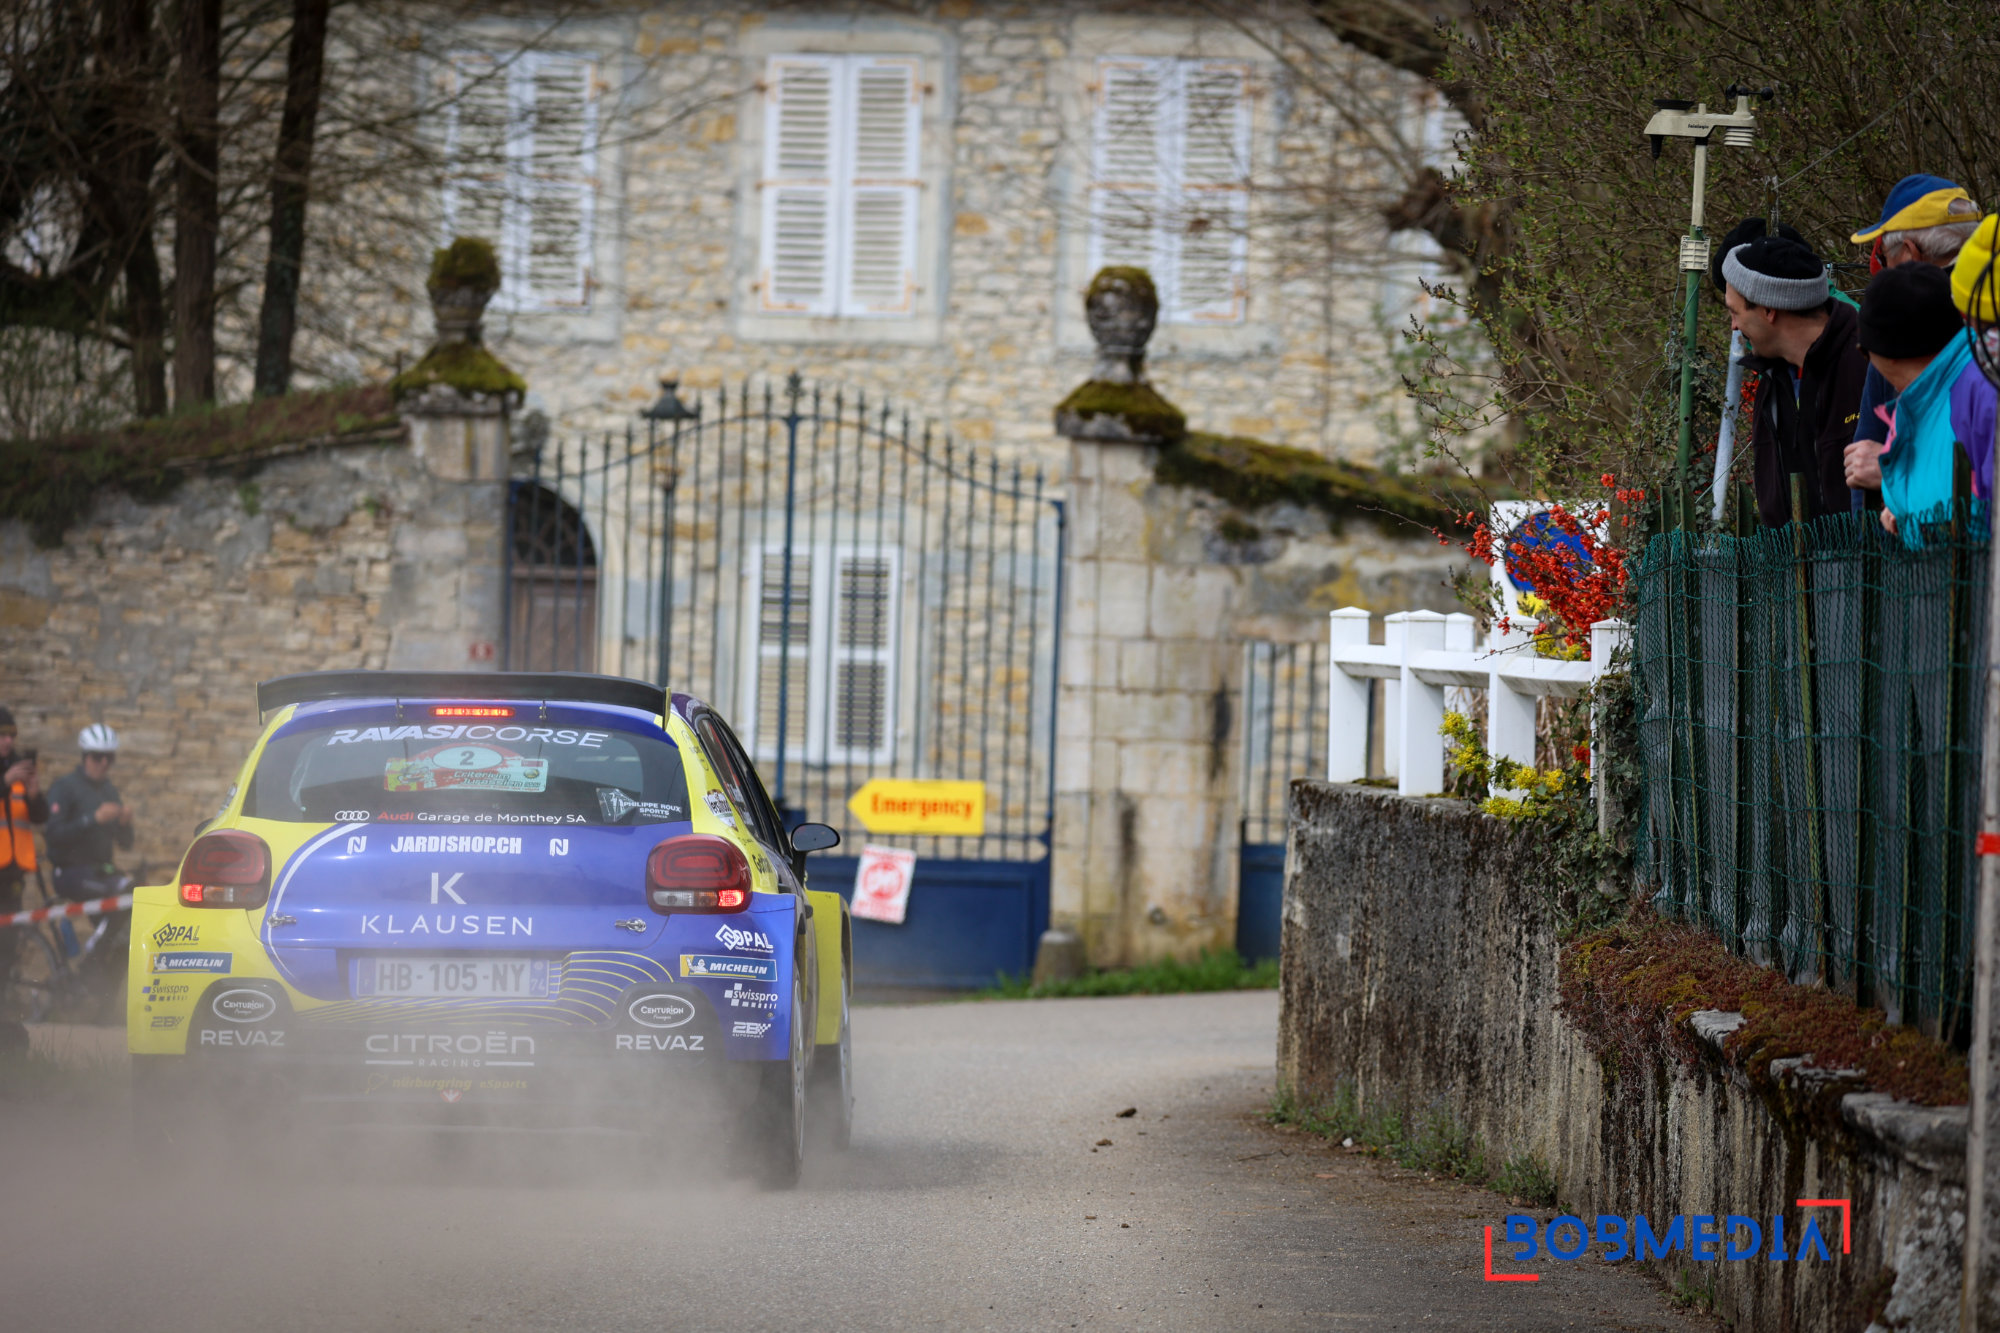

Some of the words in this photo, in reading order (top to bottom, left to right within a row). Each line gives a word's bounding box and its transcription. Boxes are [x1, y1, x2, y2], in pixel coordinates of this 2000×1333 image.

[327, 725, 608, 748] RAVASICORSE
[460, 751, 475, 766] 2
[622, 801, 659, 809] PHILIPPE
[660, 803, 682, 814] ROUX
[639, 807, 670, 816] SPORTS
[871, 792, 975, 820] Emergency
[377, 811, 415, 822] Audi
[417, 812, 470, 823] Garage
[474, 813, 492, 823] de
[497, 813, 562, 824] Monthey
[566, 815, 587, 823] SA
[391, 836, 522, 855] JARDISHOP.CH
[431, 872, 467, 905] K
[361, 914, 533, 936] KLAUSEN
[169, 958, 224, 968] MICHELIN
[709, 962, 768, 975] MICHELIN
[152, 984, 189, 995] swisspro
[530, 977, 545, 992] 74
[733, 988, 778, 1003] swisspro
[200, 1029, 286, 1047] REVAZ
[616, 1034, 705, 1051] REVAZ
[418, 1057, 482, 1068] RACING
[392, 1076, 473, 1091] nürburgring
